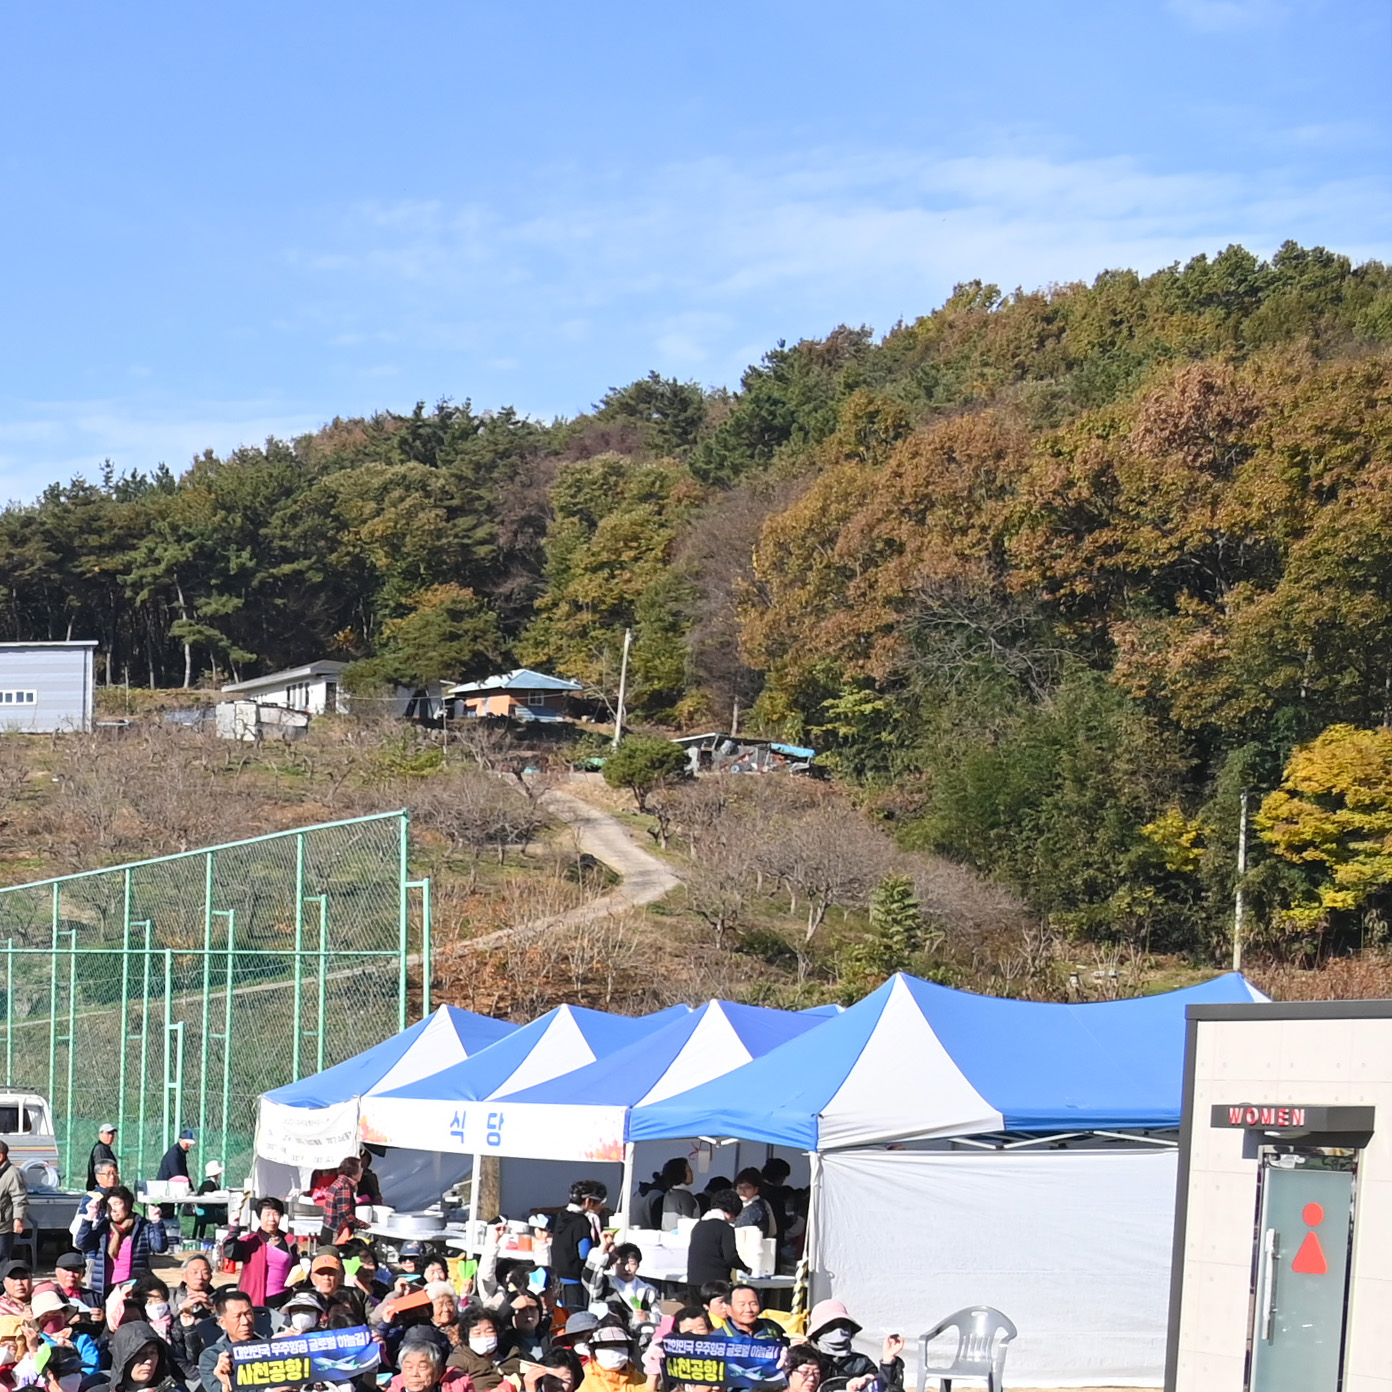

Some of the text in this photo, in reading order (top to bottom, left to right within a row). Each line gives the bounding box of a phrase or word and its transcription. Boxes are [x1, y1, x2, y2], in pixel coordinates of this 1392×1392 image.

[1229, 1107, 1304, 1126] WOMEN
[237, 1358, 309, 1386] 사천공항!
[666, 1359, 724, 1381] 사천공항!
